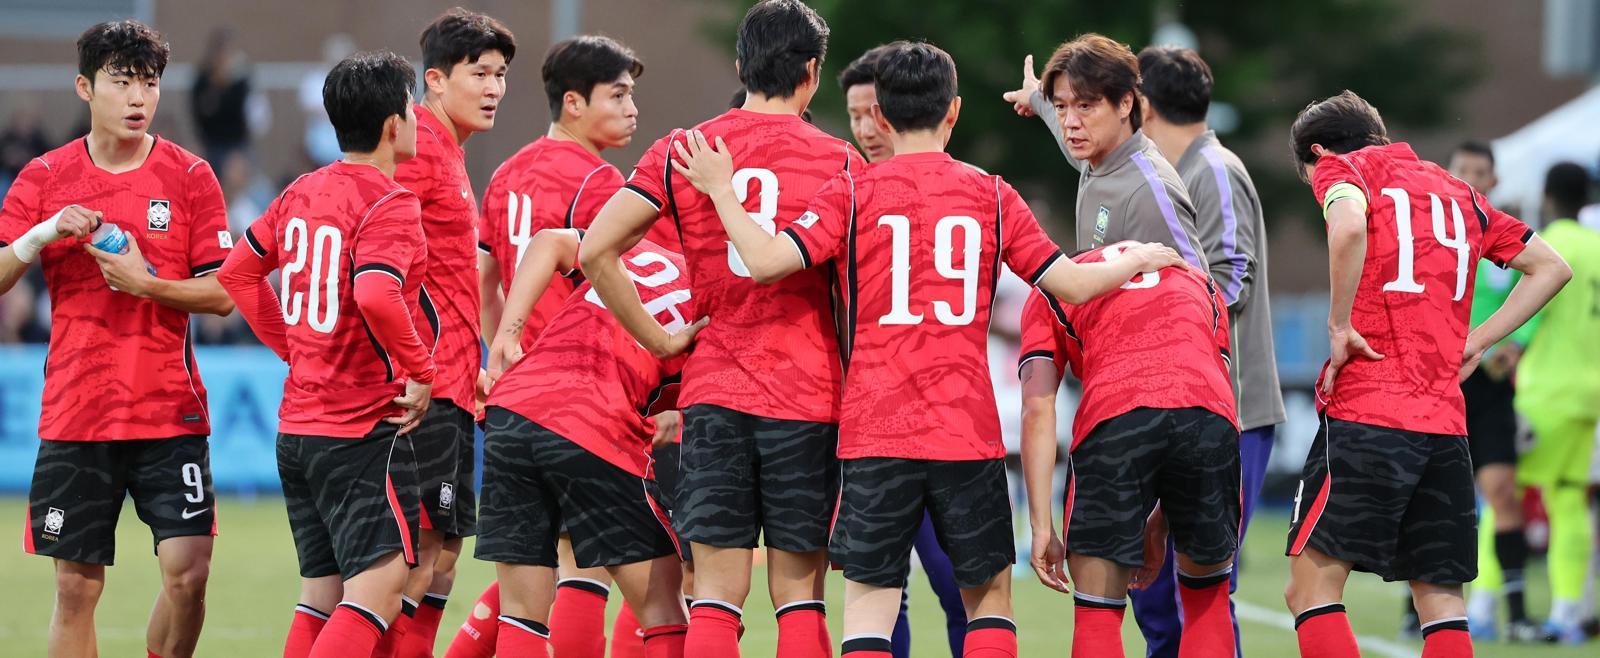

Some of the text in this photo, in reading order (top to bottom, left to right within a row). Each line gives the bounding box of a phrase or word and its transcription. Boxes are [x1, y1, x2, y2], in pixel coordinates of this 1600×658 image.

[281, 216, 342, 334] 20
[508, 190, 533, 271] 4
[877, 214, 982, 327] 19
[1381, 187, 1470, 302] 14
[181, 462, 205, 503] 9
